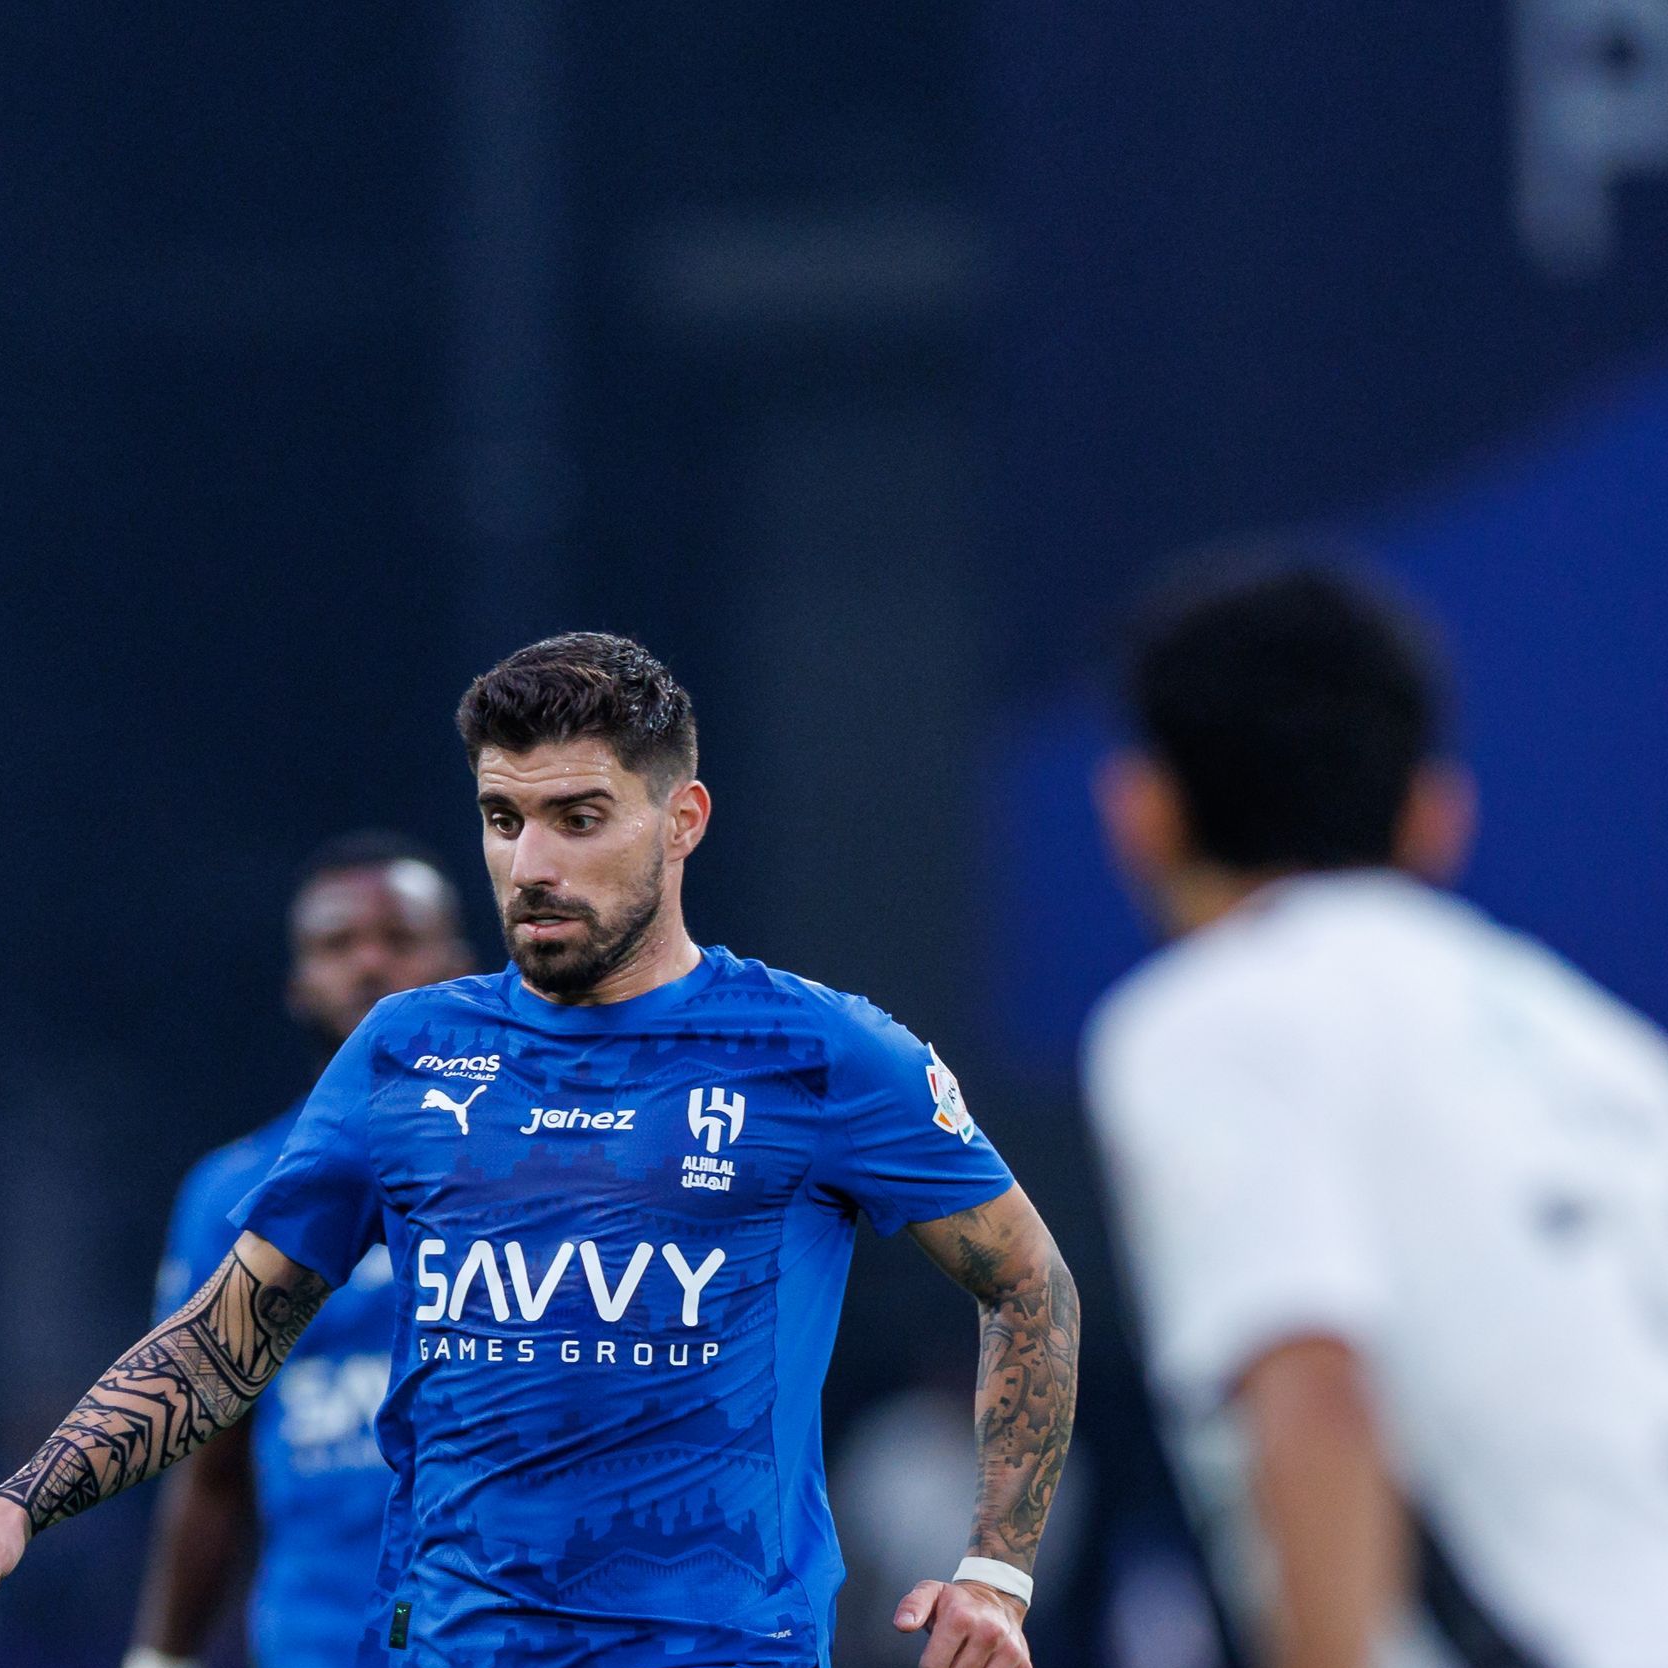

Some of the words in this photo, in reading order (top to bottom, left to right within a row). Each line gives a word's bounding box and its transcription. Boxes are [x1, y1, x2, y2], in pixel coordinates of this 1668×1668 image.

[415, 1239, 726, 1327] SAVVY
[420, 1338, 535, 1362] GAMES
[560, 1340, 719, 1366] GROUP
